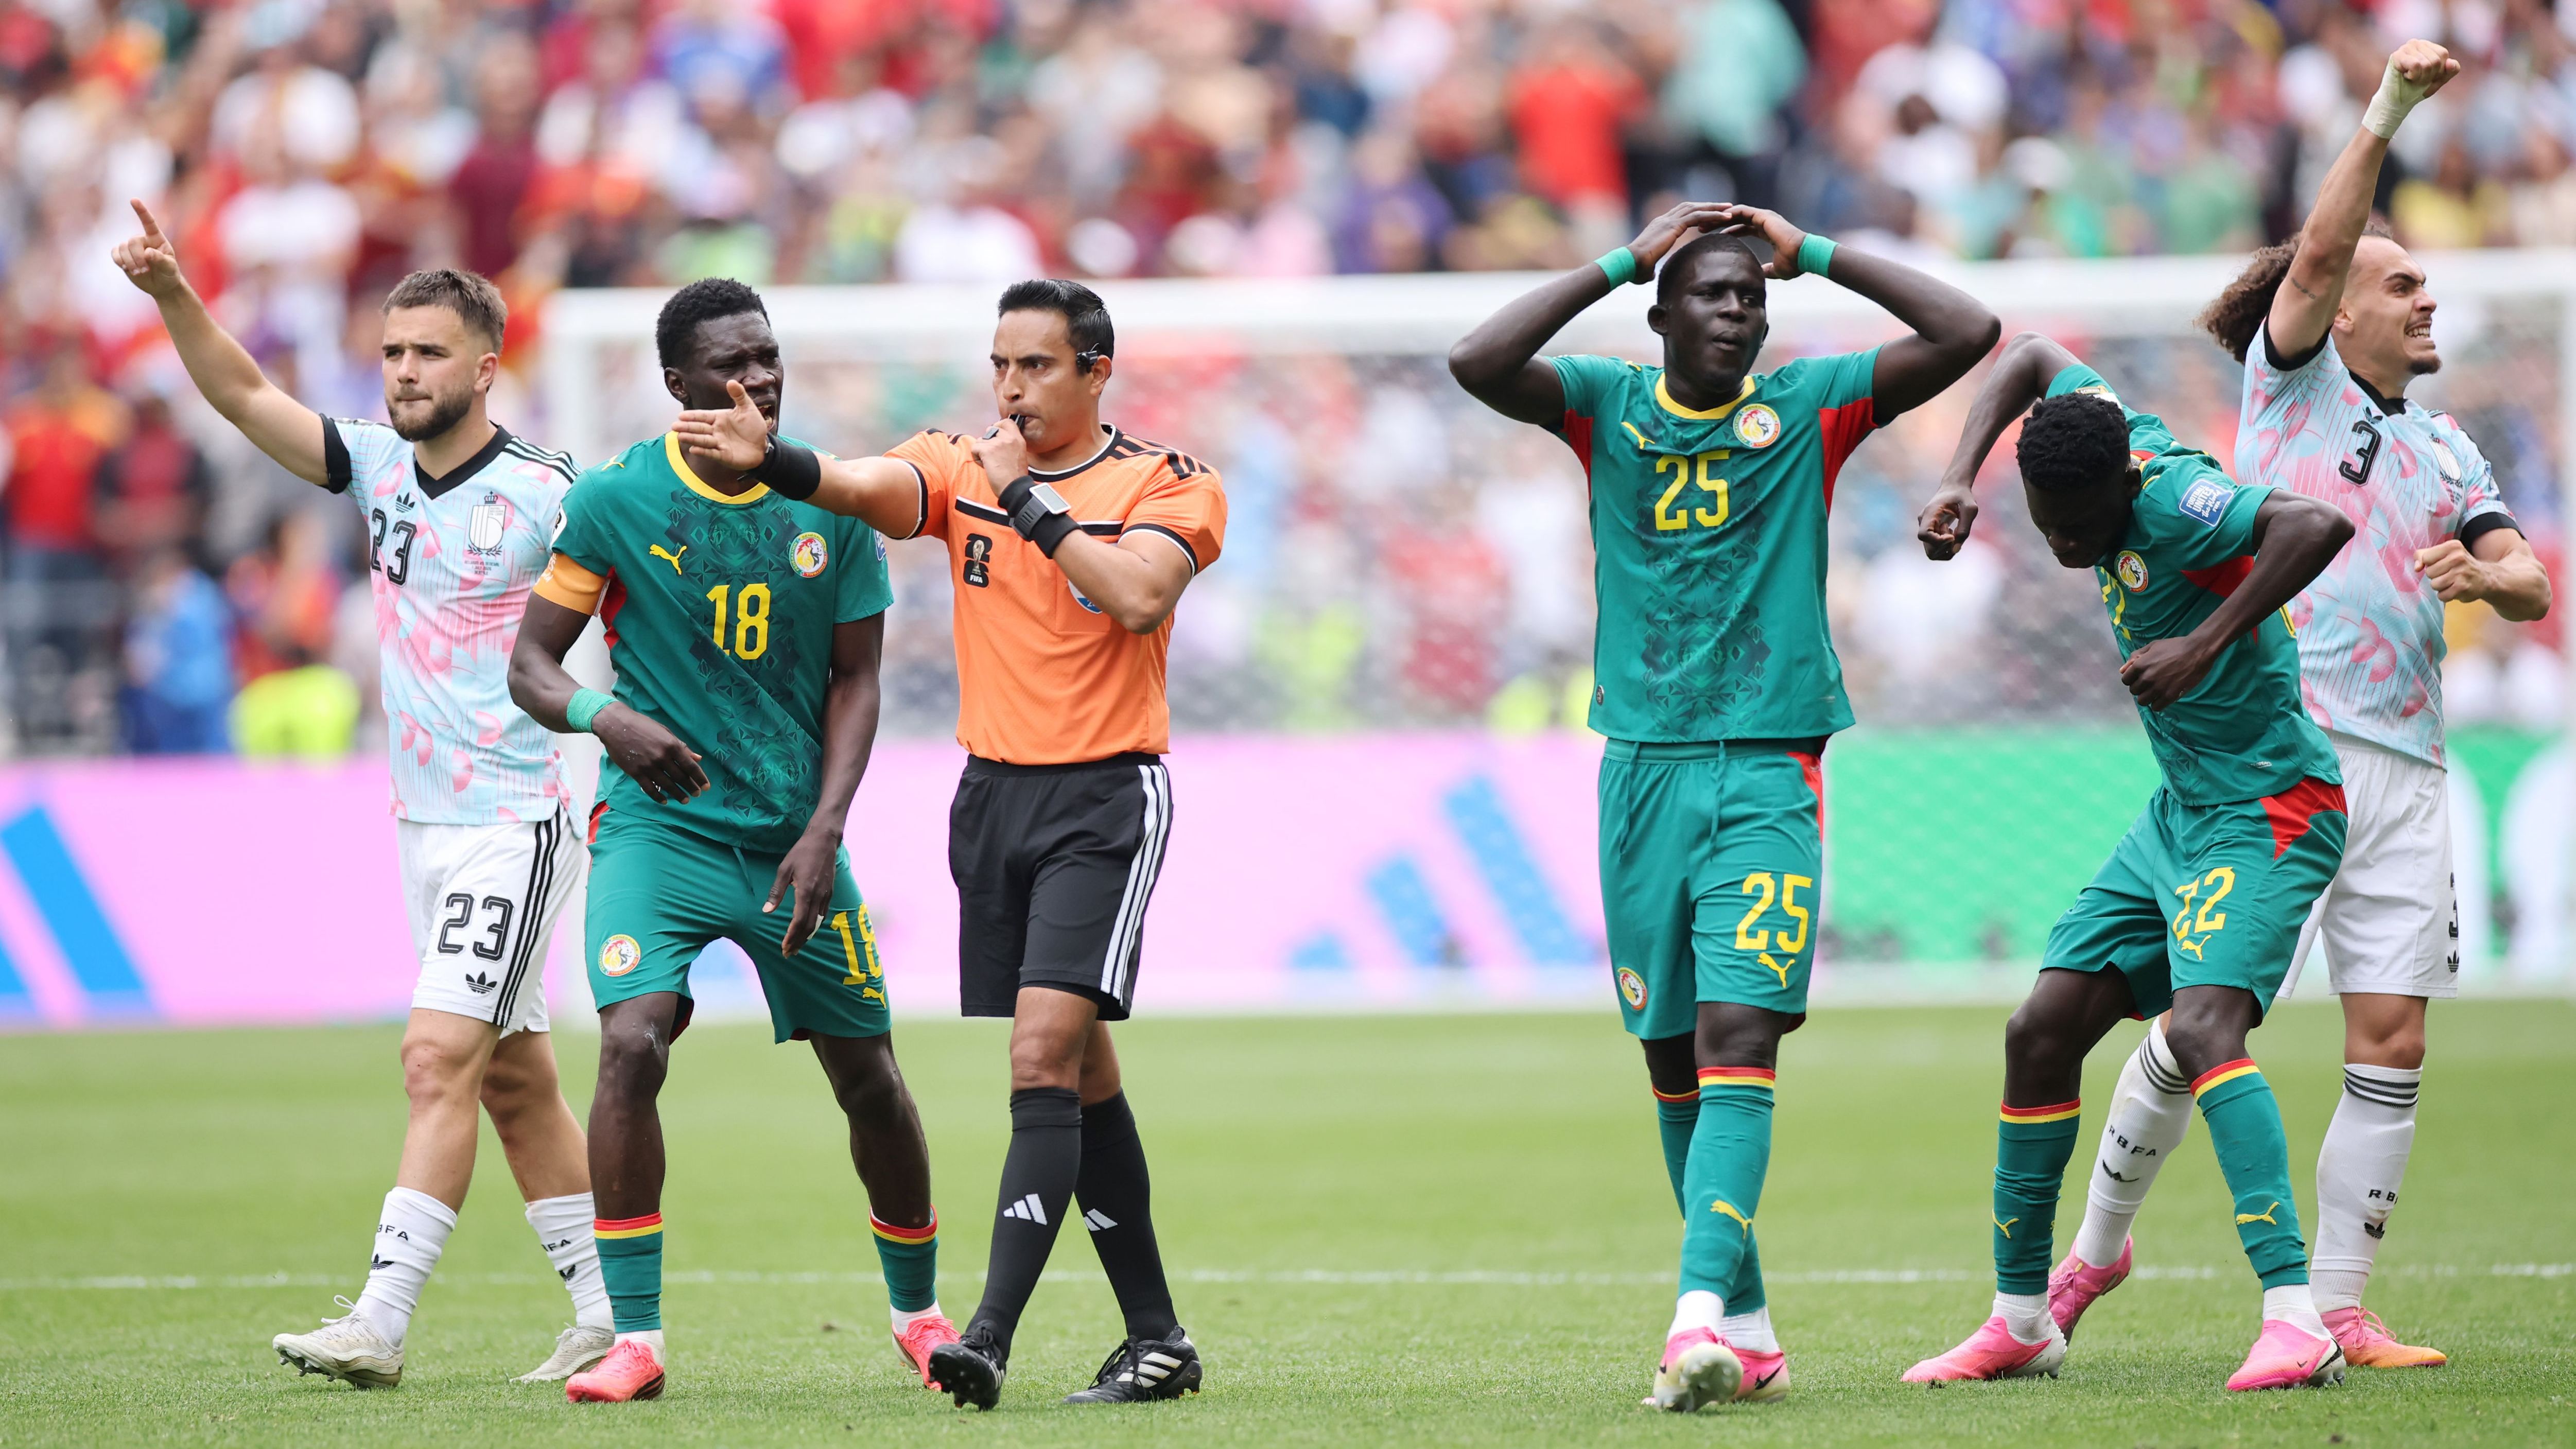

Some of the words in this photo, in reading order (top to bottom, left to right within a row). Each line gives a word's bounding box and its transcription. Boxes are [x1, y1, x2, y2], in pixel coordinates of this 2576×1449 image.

[2339, 420, 2382, 487] 3
[1655, 449, 1732, 531] 25
[2186, 485, 2204, 509] FOOTBALL
[2192, 485, 2214, 513] UNITES
[2202, 507, 2211, 518] the
[370, 508, 417, 588] 23
[970, 574, 983, 584] FIFA
[706, 583, 771, 660] 18
[437, 893, 515, 964] 23
[1734, 872, 1813, 954] 25
[2172, 867, 2236, 941] 22
[830, 902, 884, 985] 18
[2109, 1125, 2156, 1156] RBFA
[2369, 1189, 2398, 1205] RB
[541, 1239, 571, 1252] FA
